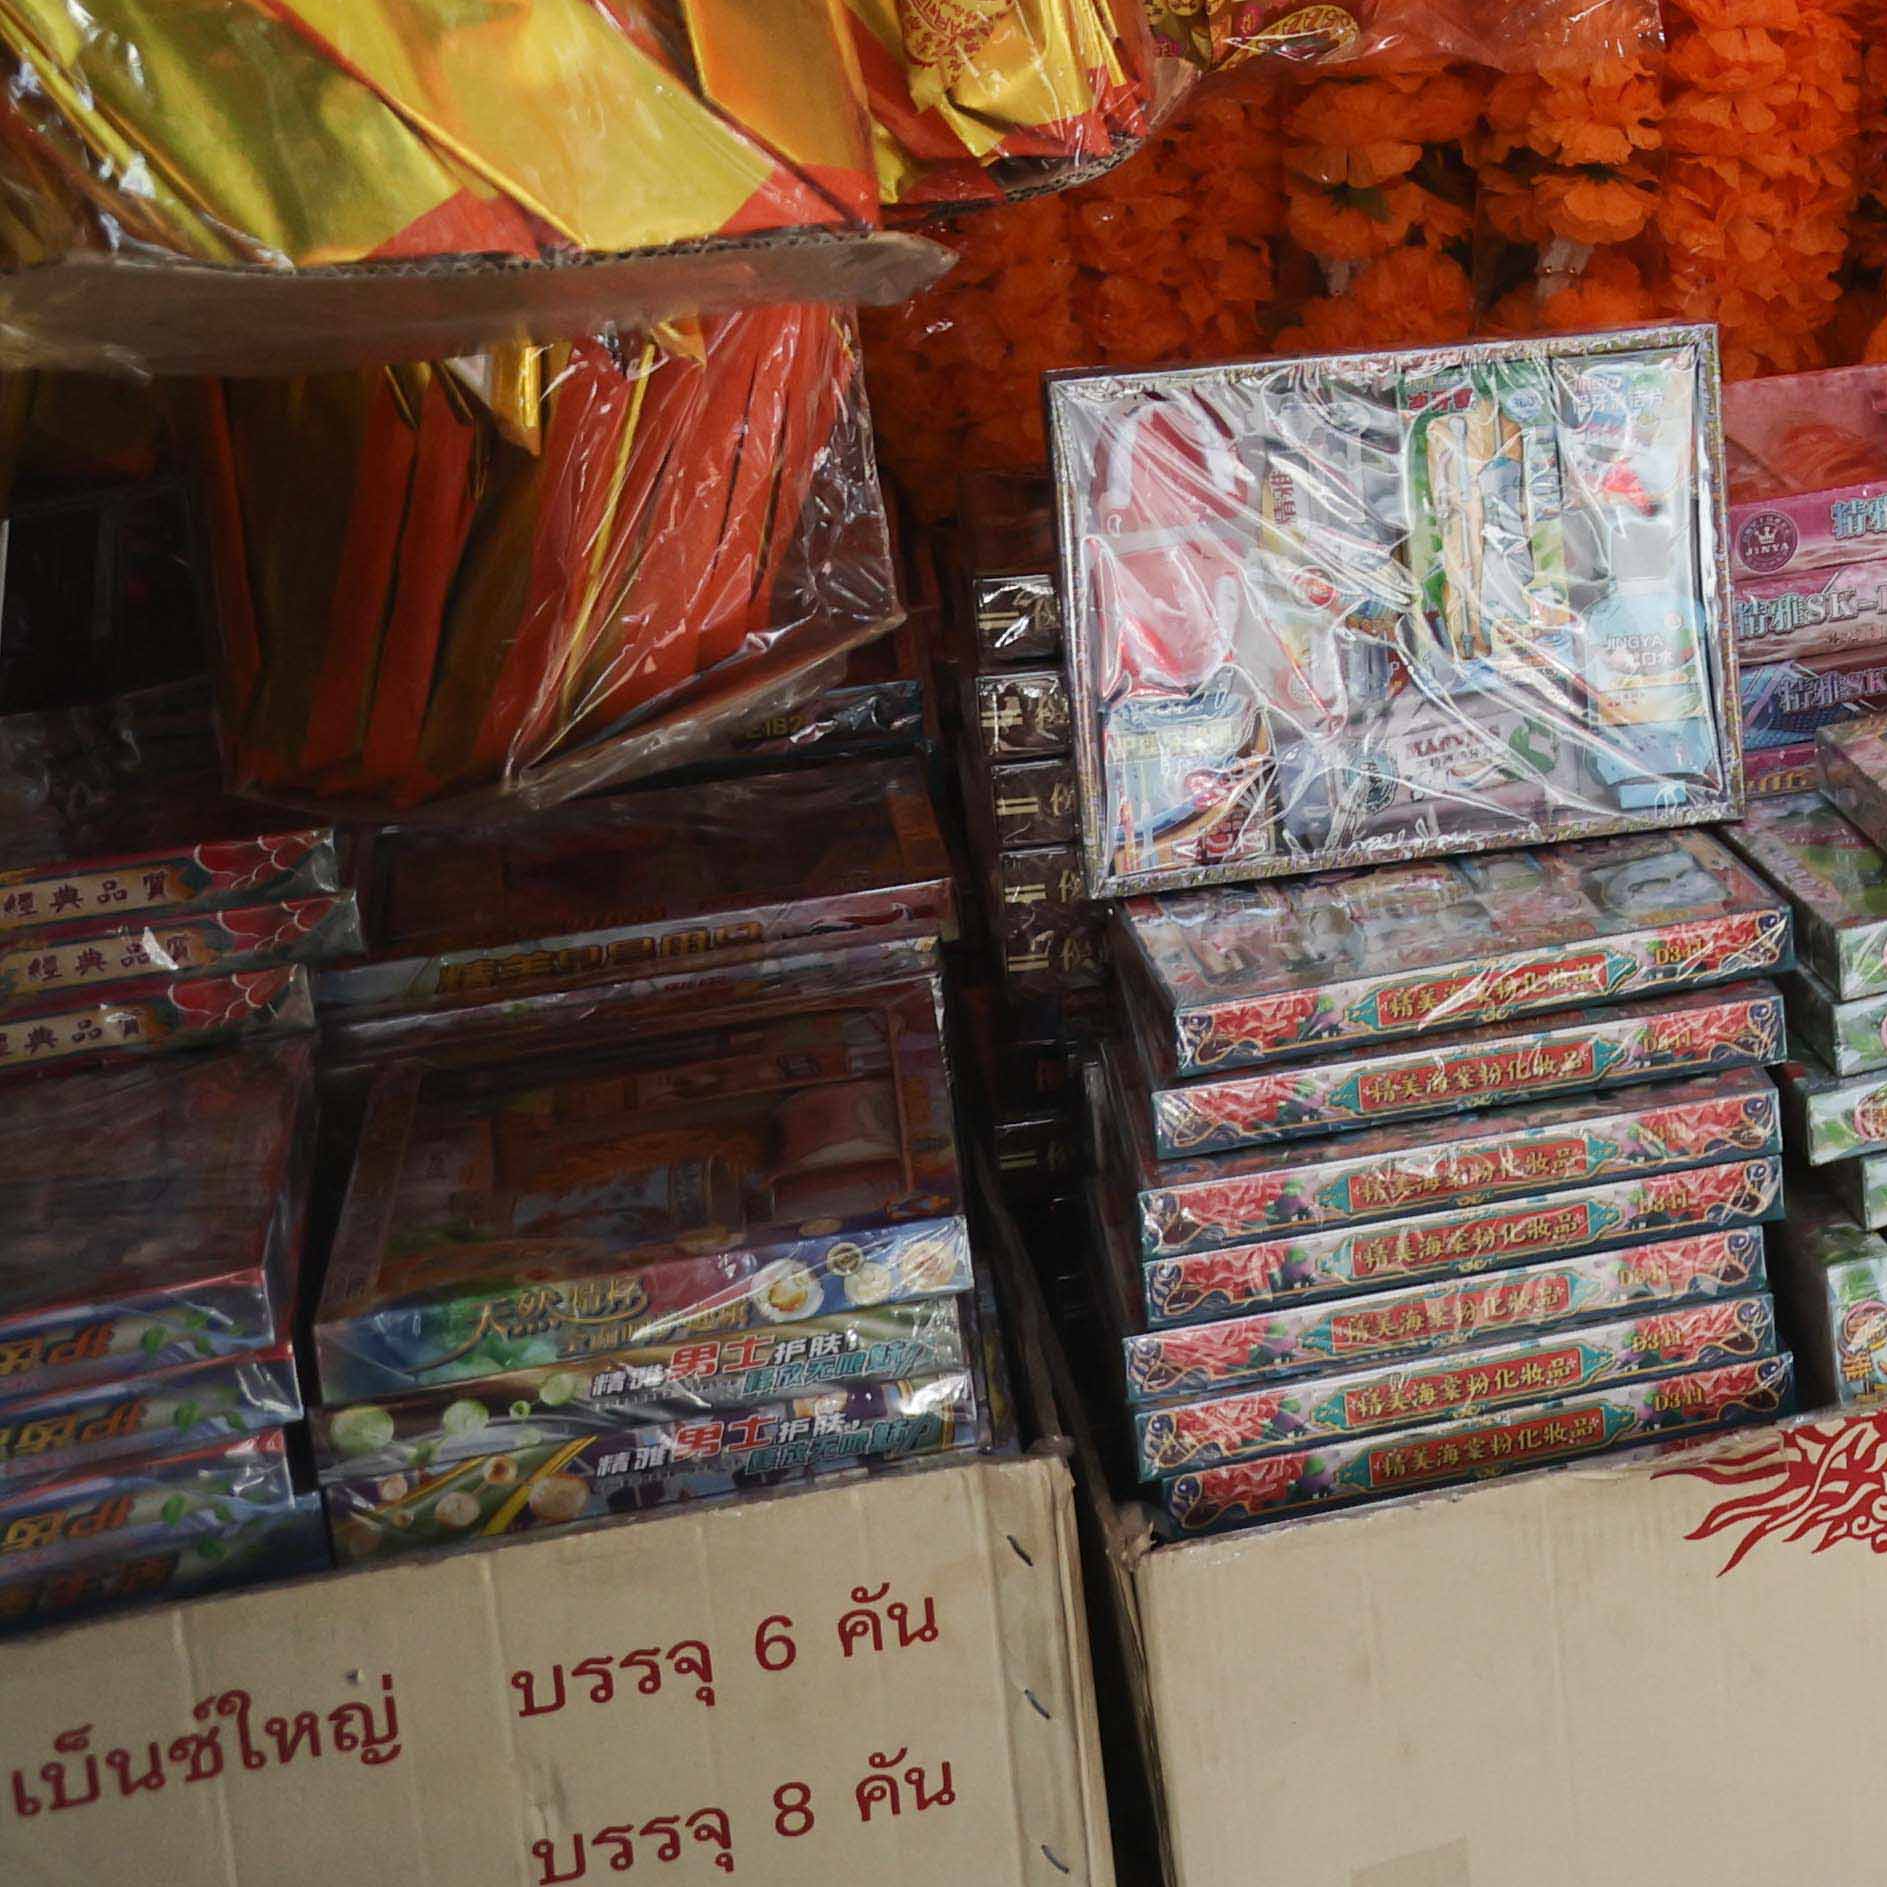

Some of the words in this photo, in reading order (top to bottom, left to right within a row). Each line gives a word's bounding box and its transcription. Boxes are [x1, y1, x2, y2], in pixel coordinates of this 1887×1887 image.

[512, 1634, 715, 1716] บรรจุ
[753, 1613, 798, 1671] 6
[836, 1581, 938, 1658] คัน
[11, 1675, 402, 1819] เบ็นซ์ใหญ่
[531, 1806, 734, 1887] บรรจุ
[773, 1781, 815, 1838] 8
[856, 1744, 956, 1824] คัน
